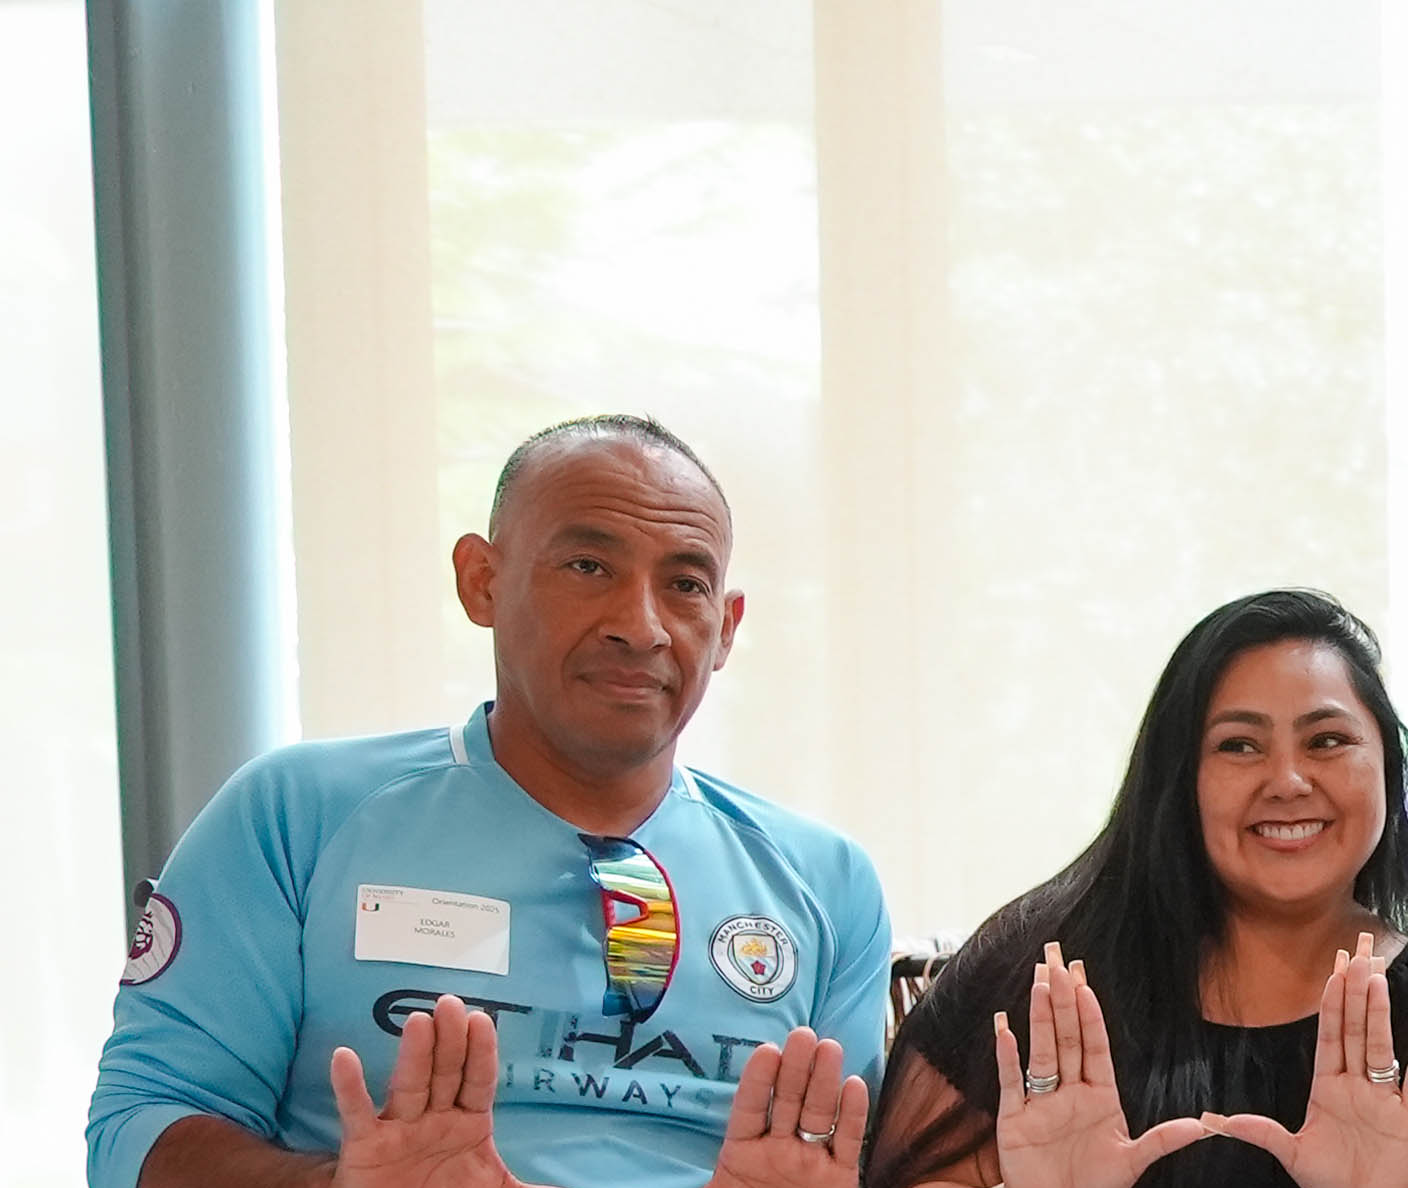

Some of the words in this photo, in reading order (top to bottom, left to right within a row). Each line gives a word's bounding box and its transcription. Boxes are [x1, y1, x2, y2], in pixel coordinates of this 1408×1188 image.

[419, 918, 450, 929] EDGAR
[414, 927, 456, 938] MORALES
[717, 920, 789, 946] MANCHESTER
[749, 985, 775, 996] CITY
[505, 1062, 717, 1110] IRWAYS
